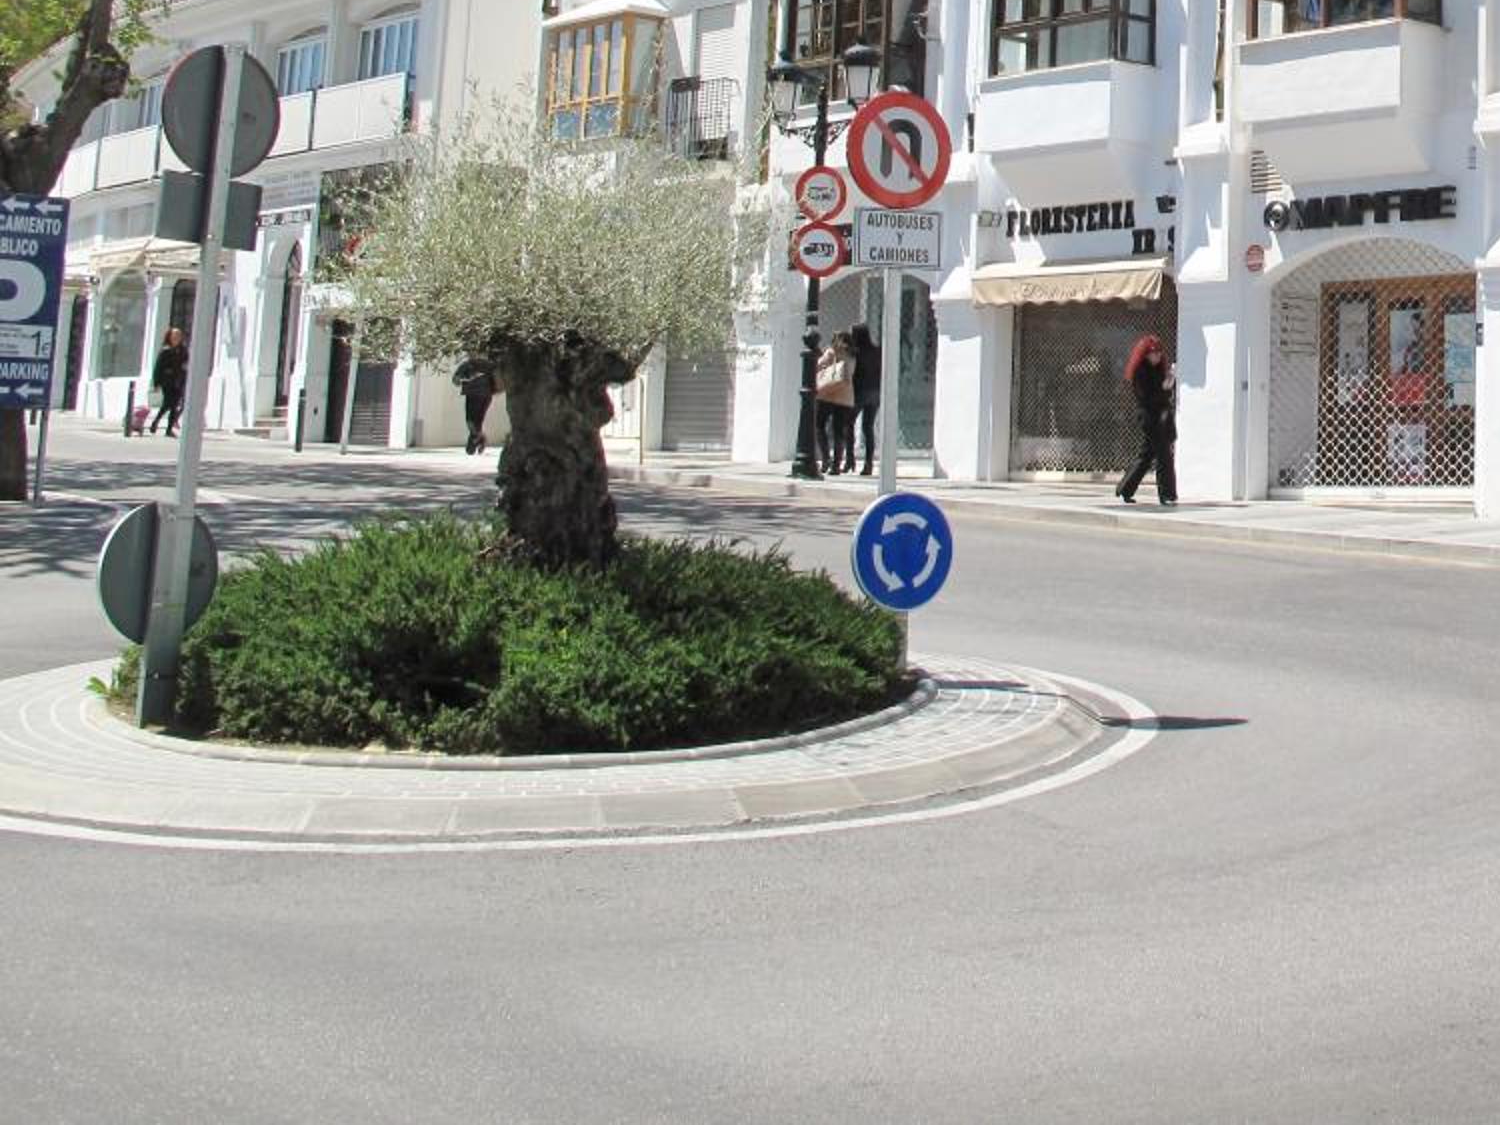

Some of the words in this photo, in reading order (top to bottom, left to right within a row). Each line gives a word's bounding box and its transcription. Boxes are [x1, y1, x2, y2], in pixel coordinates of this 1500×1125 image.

[1289, 185, 1457, 230] MAPFRE
[867, 212, 935, 231] AUTOBUSES
[896, 233, 905, 246] Y
[868, 246, 930, 265] CAMIONES
